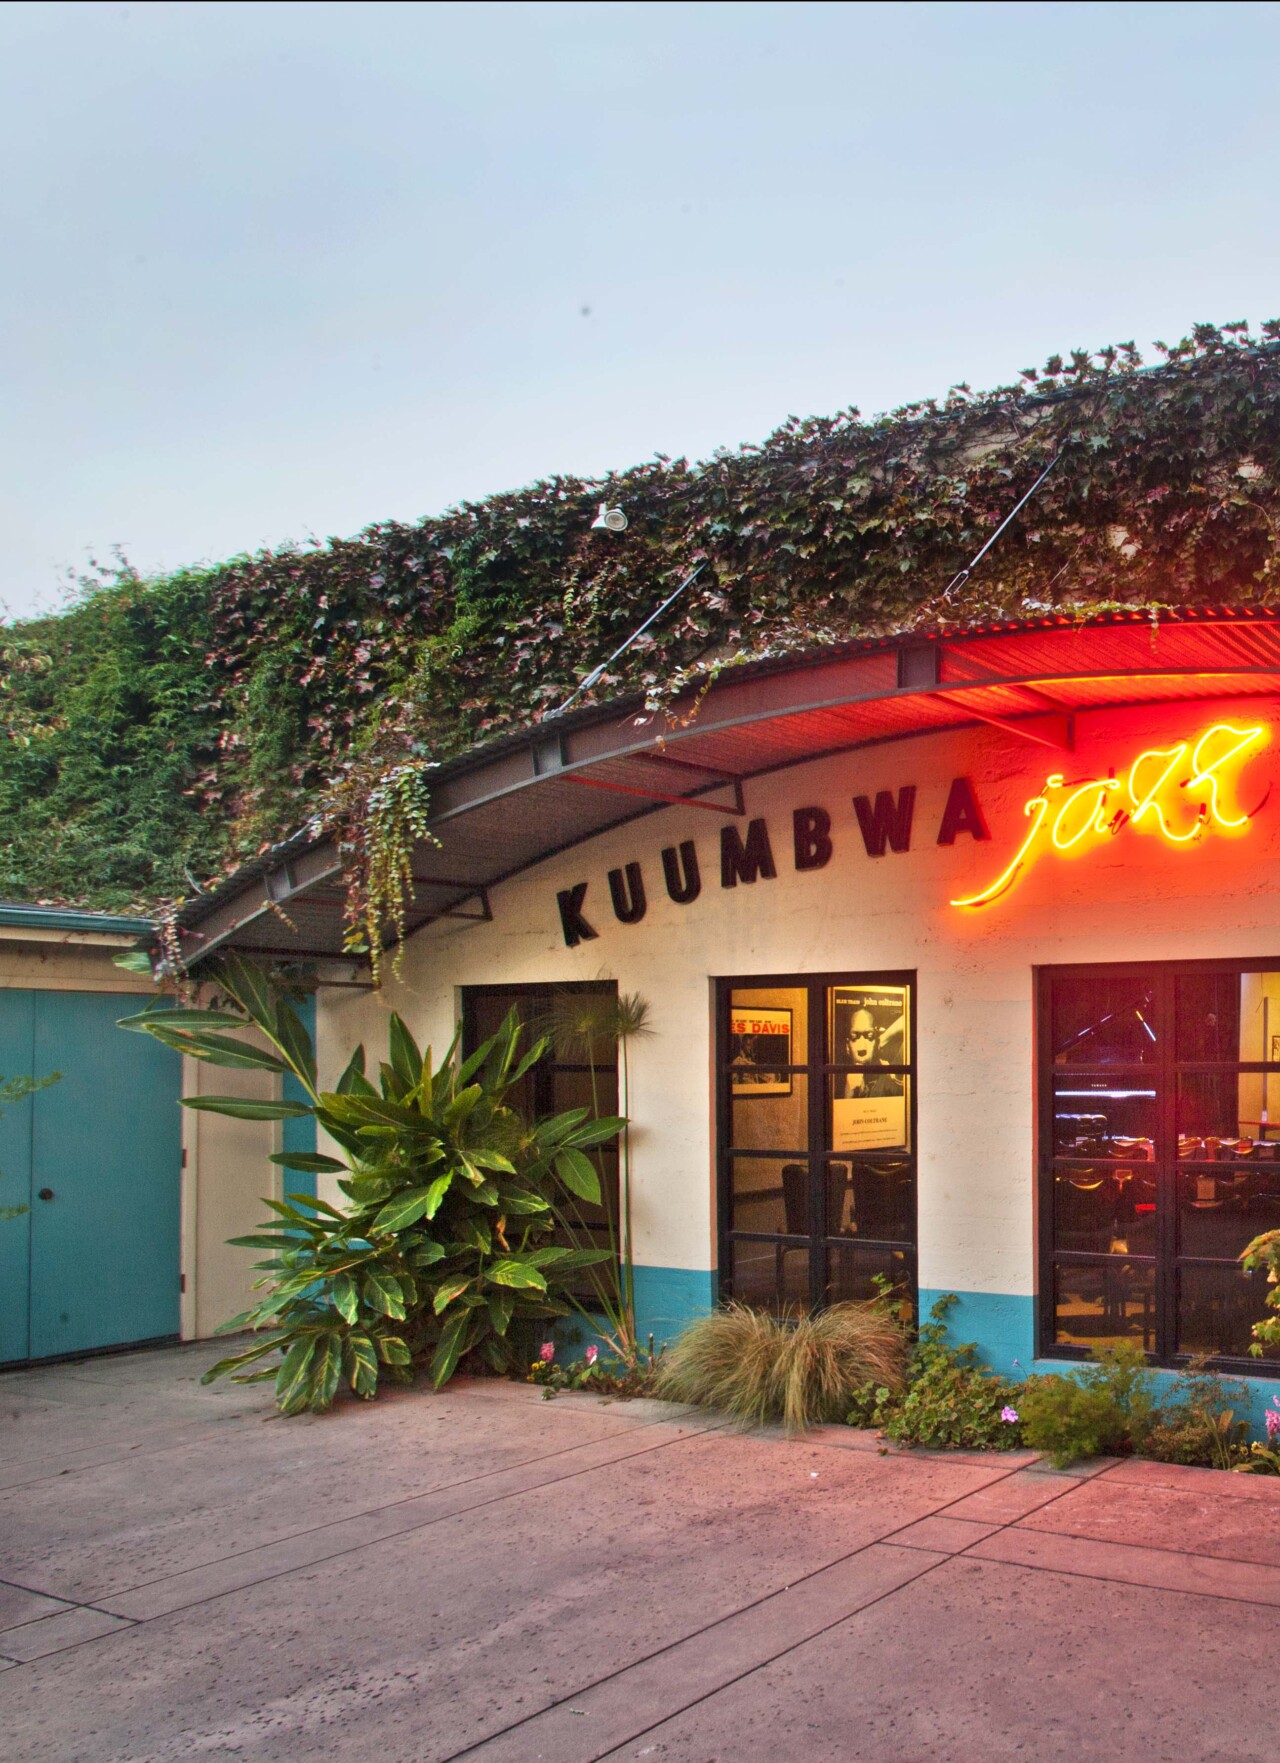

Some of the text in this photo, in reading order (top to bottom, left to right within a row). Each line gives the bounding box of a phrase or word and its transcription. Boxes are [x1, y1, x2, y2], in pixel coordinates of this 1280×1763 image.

[556, 777, 991, 948] KUUMBWA
[950, 724, 1264, 906] jazz
[863, 997, 878, 1007] john
[878, 998, 903, 1007] coltrane
[752, 1023, 790, 1034] DAVIS
